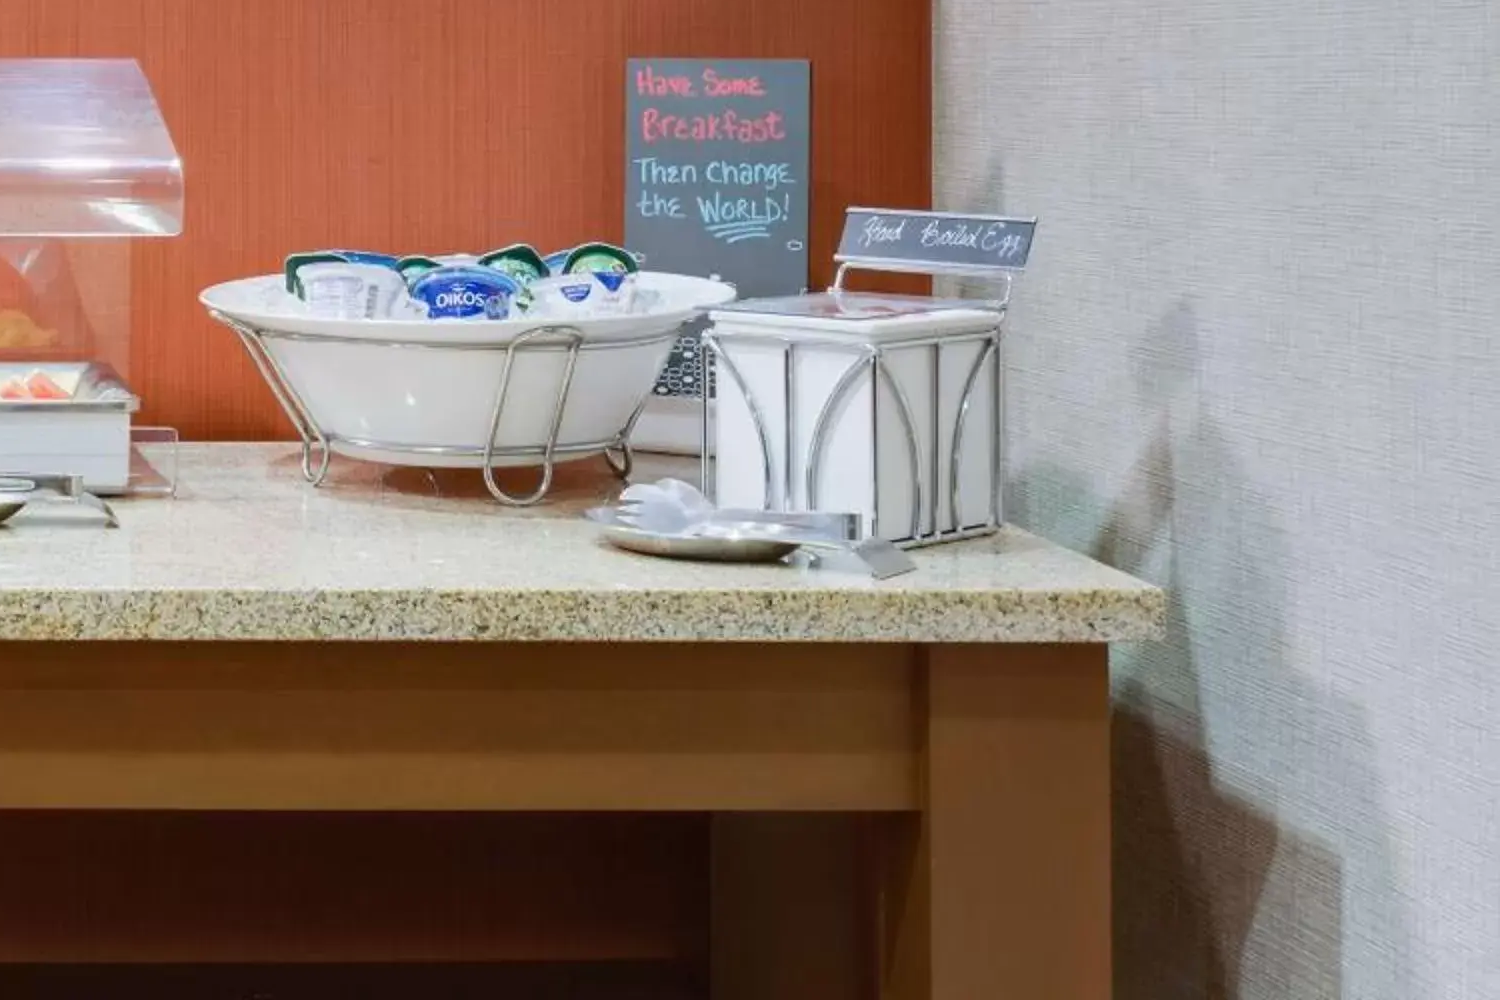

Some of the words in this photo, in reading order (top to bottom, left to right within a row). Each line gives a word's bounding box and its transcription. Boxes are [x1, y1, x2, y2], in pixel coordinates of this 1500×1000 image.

[636, 64, 697, 97] Have
[702, 67, 767, 97] Some
[642, 108, 786, 143] Breakfast
[632, 157, 697, 184] Then
[635, 190, 687, 218] the
[920, 219, 983, 250] Boiled
[981, 221, 1024, 258] Egg
[435, 291, 486, 309] OIKOS
